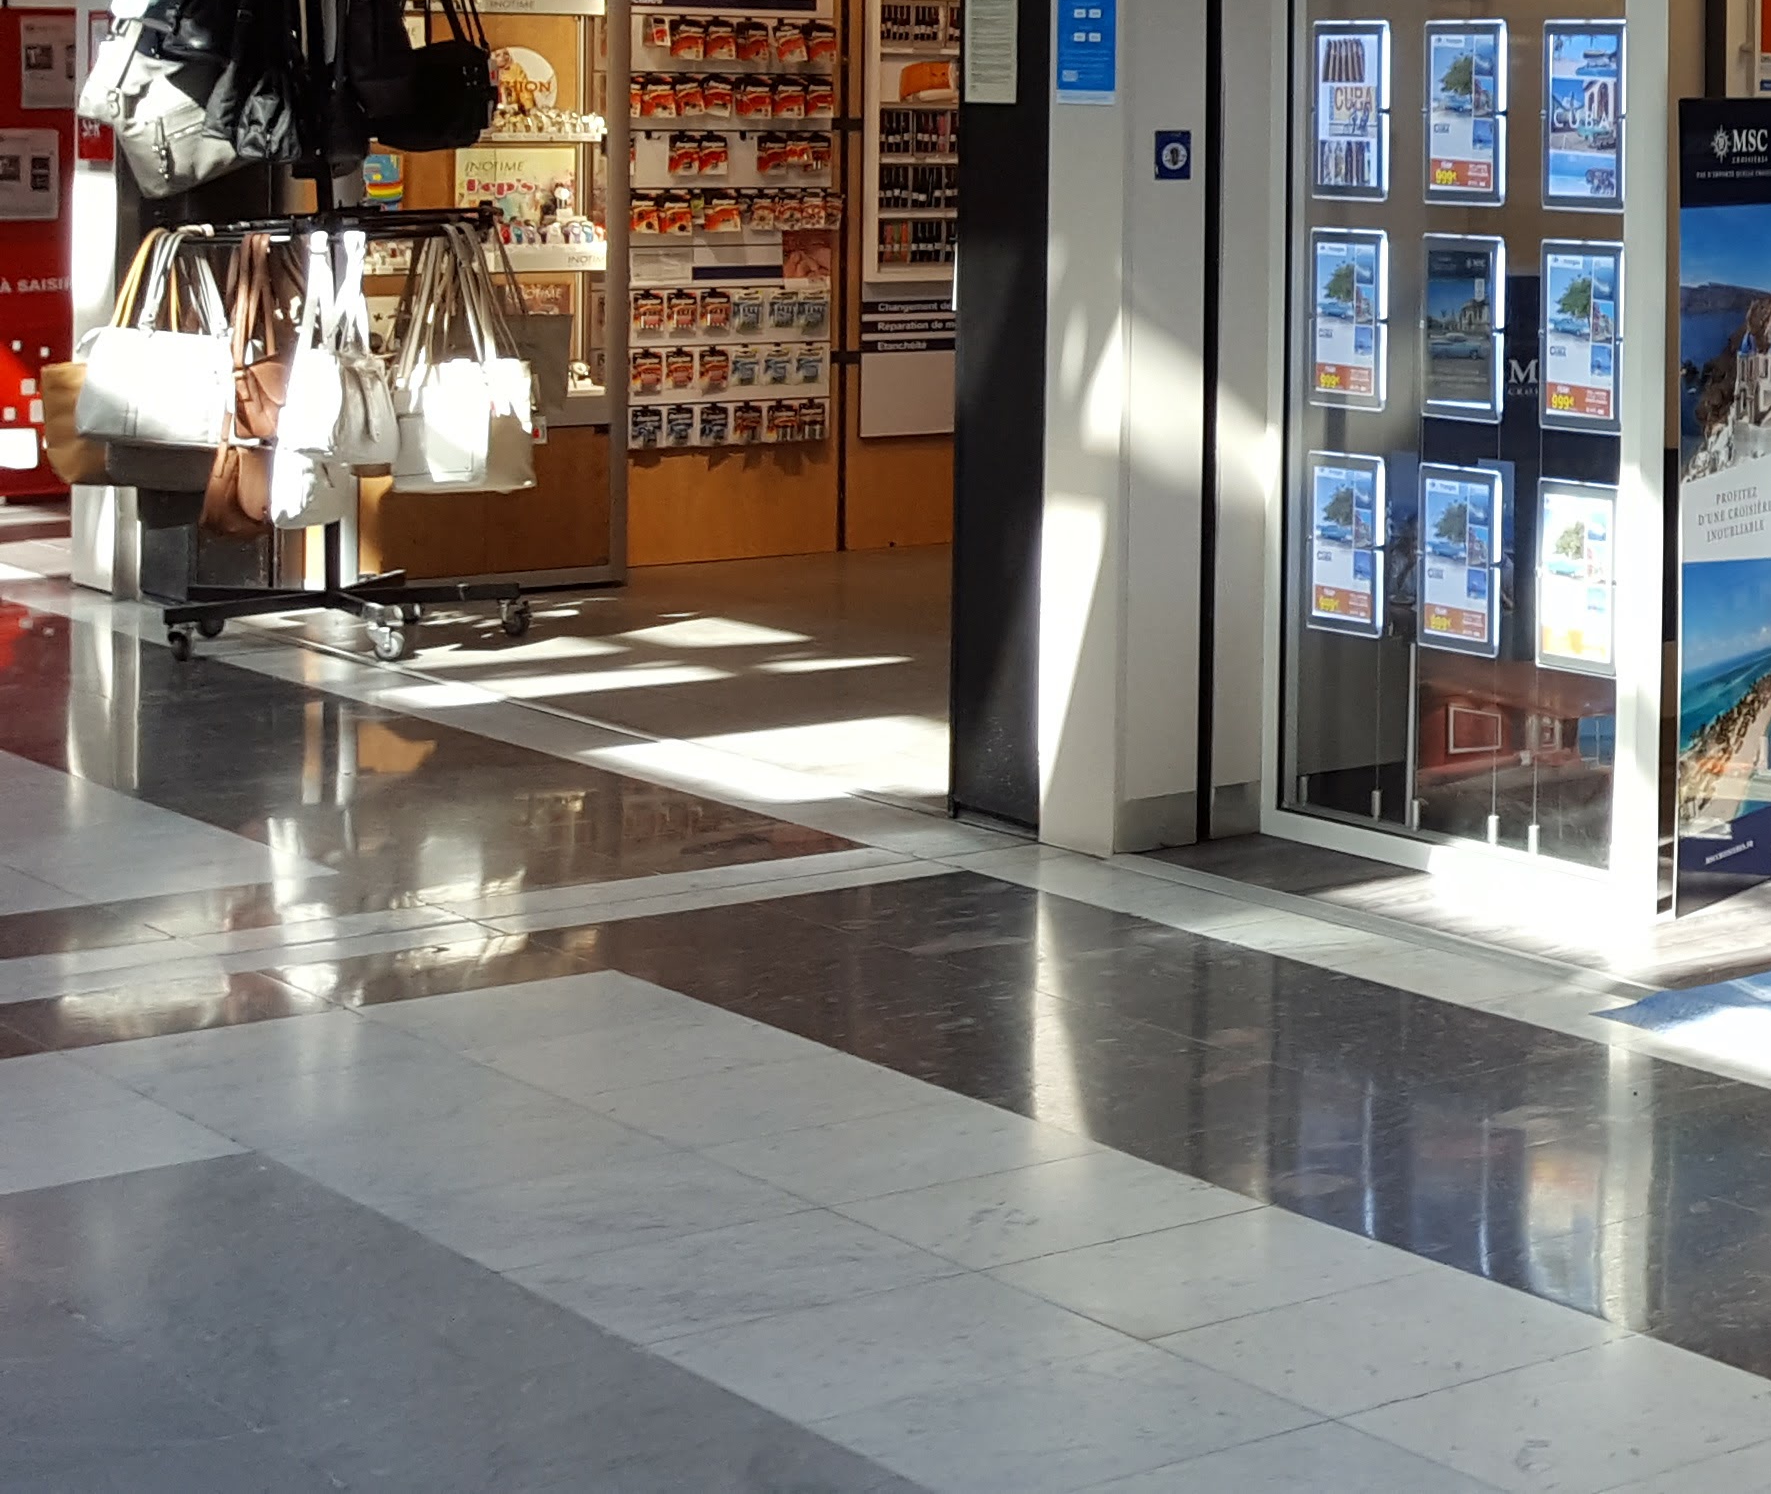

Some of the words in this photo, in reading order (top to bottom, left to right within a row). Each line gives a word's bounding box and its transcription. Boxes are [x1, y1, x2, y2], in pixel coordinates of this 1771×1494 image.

[1731, 129, 1768, 153] MSC
[1716, 486, 1758, 506] PROFITEZ
[1698, 509, 1726, 526] D'UNE
[1706, 518, 1765, 543] INOUBLIABLE
